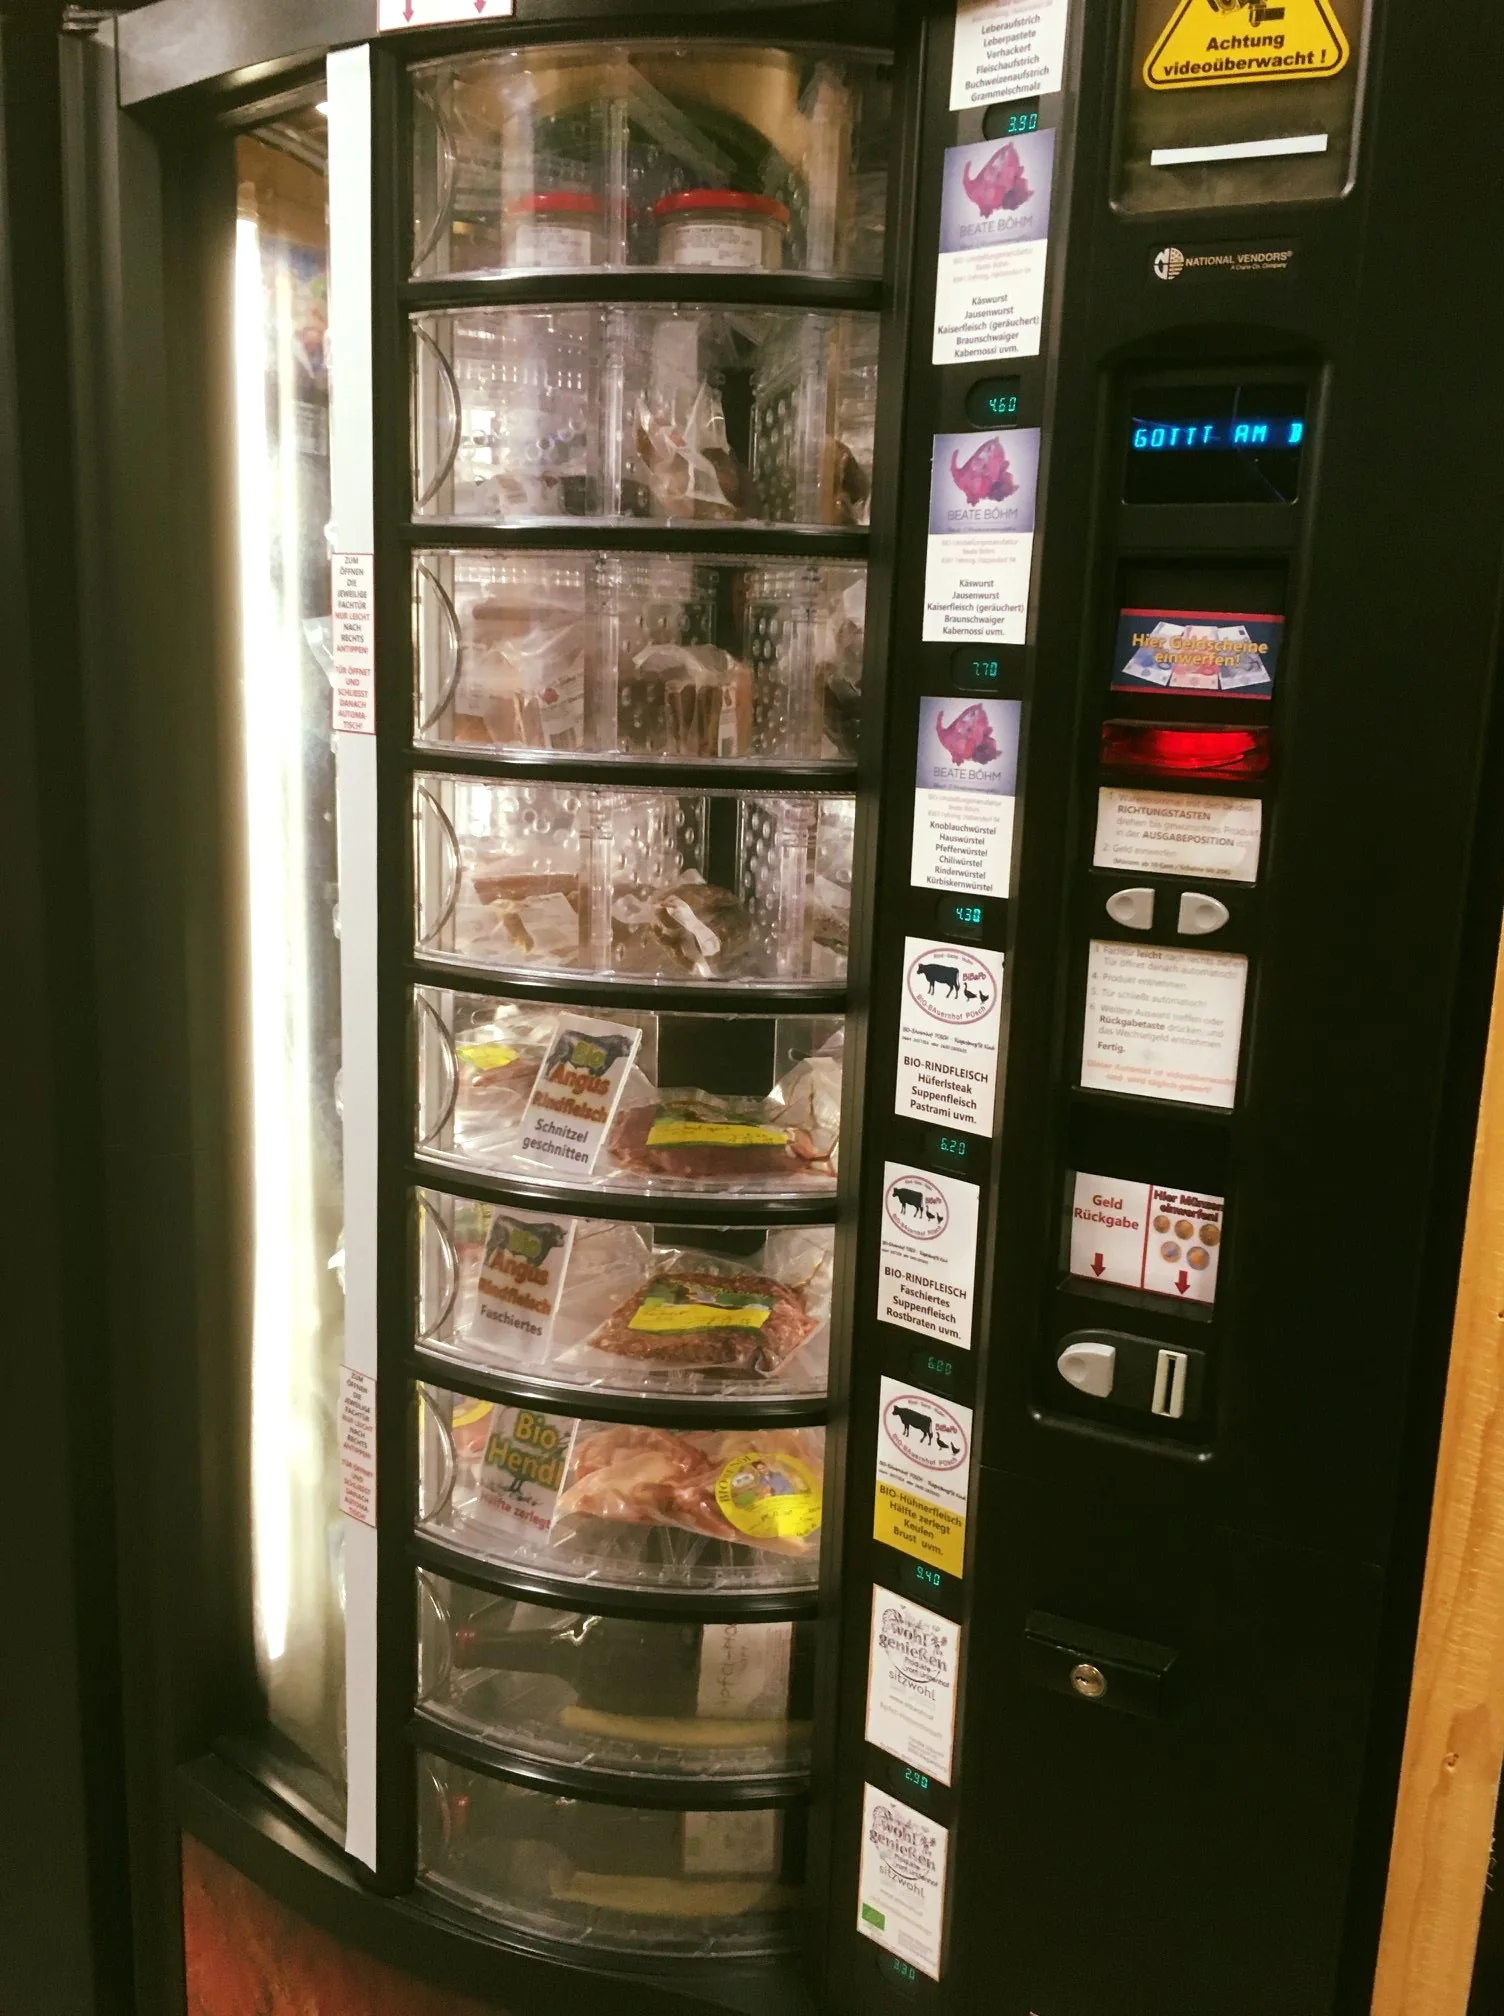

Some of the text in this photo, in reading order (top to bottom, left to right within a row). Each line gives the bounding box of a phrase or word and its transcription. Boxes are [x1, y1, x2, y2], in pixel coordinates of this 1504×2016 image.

[981, 15, 1041, 35] Leberaufstrich
[983, 29, 1036, 47] Leberpastete
[1206, 34, 1285, 51] Achtung
[986, 43, 1031, 59] Verhackert
[976, 55, 1040, 74] Fleischaufstrich
[1164, 51, 1314, 76] videoüberwacht
[965, 66, 1049, 90] Buchweizenaufstrich
[971, 81, 1041, 102] Grammelschmalz
[1008, 113, 1037, 133] 3.90
[959, 221, 995, 238] BEATE
[1185, 255, 1235, 267] NATIONAL
[971, 294, 1008, 306] Käswurst
[964, 306, 1014, 320] Jausenwurst
[937, 316, 1039, 335] Kaiserfleisch (geräuchert)
[956, 332, 1019, 346] Braunschwaiger
[954, 346, 997, 358] Kabernossi
[1234, 424, 1268, 443] AM
[947, 509, 981, 521] BEATE
[344, 556, 359, 565] ZUM
[340, 565, 364, 576] ÖFFNEN
[347, 579, 357, 587] DIE
[959, 579, 994, 588] Käswurst
[952, 591, 1000, 600] Jausenwurst
[927, 603, 1025, 614] Kaiserfleisch (geräuchert)
[343, 624, 361, 632] NACH
[944, 614, 1005, 625] Braunschwaiger
[341, 634, 364, 643] RECHTS
[942, 626, 984, 636] Kabernossi
[1131, 633, 1269, 654] Hier Geldscheine
[1154, 650, 1241, 666] einwerfen!
[933, 766, 966, 780] BEATE
[1117, 805, 1211, 821] RICHTUNGSTASTEN
[929, 820, 996, 836] Knoblauchwürstel
[939, 834, 985, 846] Hauswürstel
[1142, 830, 1234, 847] AUSGABEPOSITION
[935, 844, 987, 857] Pfefferwürstel
[939, 855, 983, 868] Chiliwürstel
[935, 866, 986, 879] Rinderwürstel
[926, 876, 993, 892] Kürbiskernwürstel
[955, 907, 982, 923] 4.30
[1137, 949, 1162, 960] leicht
[1099, 1015, 1165, 1031] Rückgabetaste
[904, 1056, 989, 1083] BIO-RINDFLEISCH
[549, 1063, 611, 1095] Angus
[911, 1085, 977, 1110] Suppenfleisch
[910, 1100, 977, 1124] Pastrami uvm.
[534, 1118, 589, 1143] Schnitzel
[522, 1136, 589, 1164] geschnitten
[941, 1137, 966, 1155] 6.20
[1092, 1194, 1123, 1210] Geld
[1074, 1207, 1139, 1230] Rückgabe
[884, 1266, 967, 1299] BIO-RINDFLEISCH
[900, 1284, 950, 1308] Faschiertes
[892, 1295, 957, 1324] Suppenfleisch
[480, 1304, 543, 1336] Faschiertes
[886, 1306, 962, 1340] Rostbraten uvm.
[515, 1410, 558, 1450] Bio
[485, 1433, 566, 1491] Hendl
[879, 1484, 962, 1527] BIO-Hühnerfleisch
[514, 1507, 552, 1533] zerlegt
[889, 1502, 950, 1535] Hälfte zerlegt
[904, 1519, 934, 1539] Keulen
[893, 1526, 944, 1556] Brust uvm.
[888, 1668, 936, 1700] sitzwohl
[879, 1864, 925, 1898] sitzwohl
